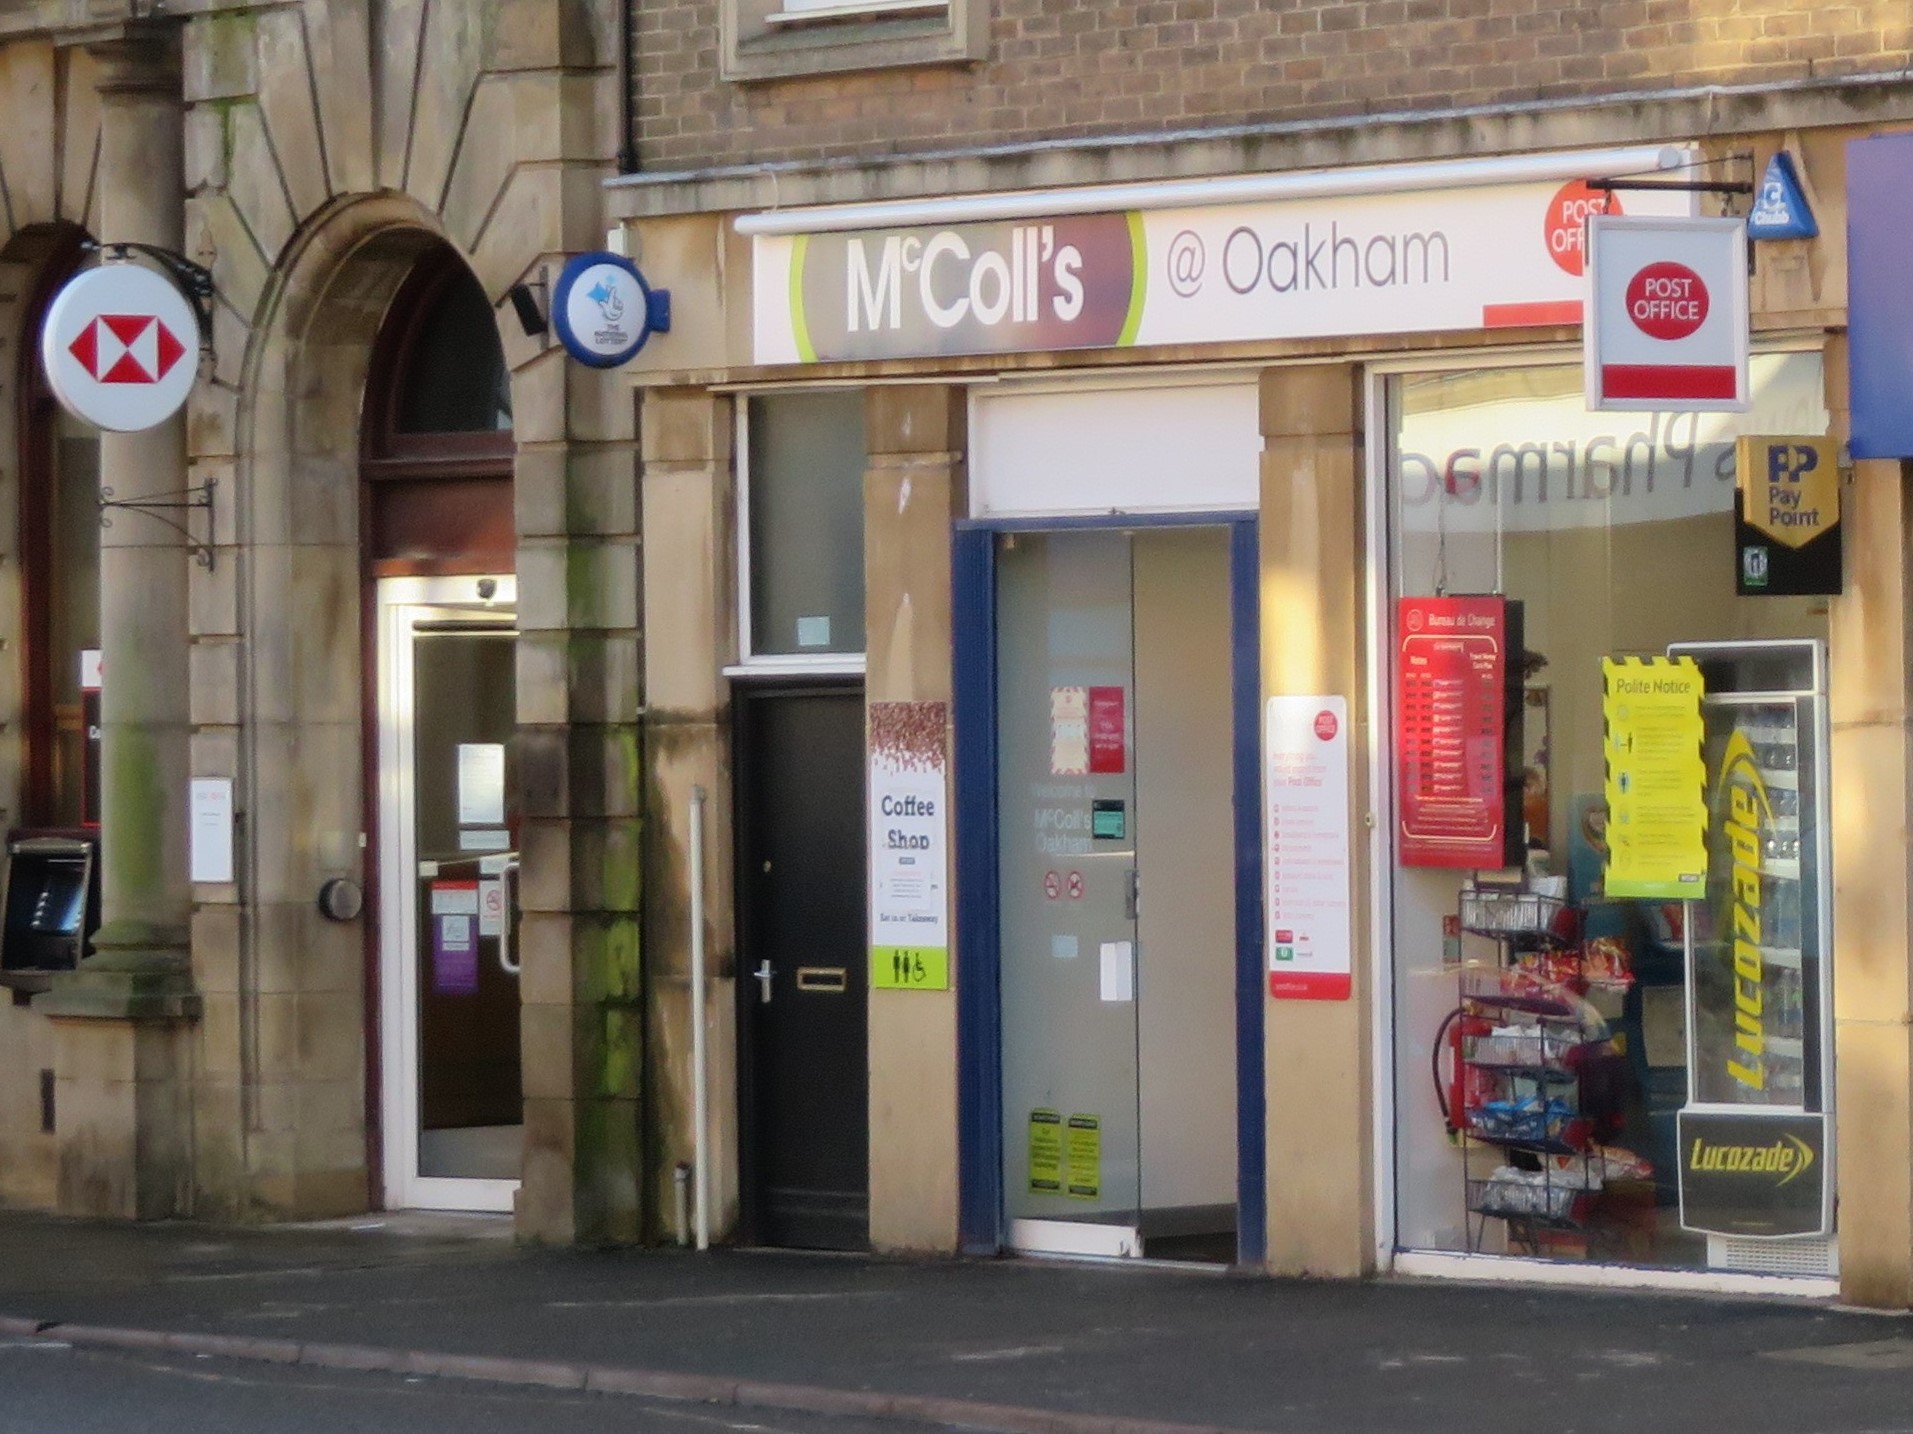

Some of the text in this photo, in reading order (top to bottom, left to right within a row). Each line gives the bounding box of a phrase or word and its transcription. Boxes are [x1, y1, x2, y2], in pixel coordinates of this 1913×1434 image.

[1551, 227, 1586, 253] OFF
[847, 220, 1450, 333] McColl's @ Oakham
[1645, 277, 1693, 298] POST
[1633, 299, 1700, 320] OFFICE
[1769, 486, 1801, 509] Pay
[1769, 506, 1819, 527] Point
[1616, 678, 1691, 694] Polite Notice
[881, 794, 935, 816] Coffee
[1724, 785, 1765, 1091] Lucozade
[1689, 1137, 1795, 1172] Lucozade
